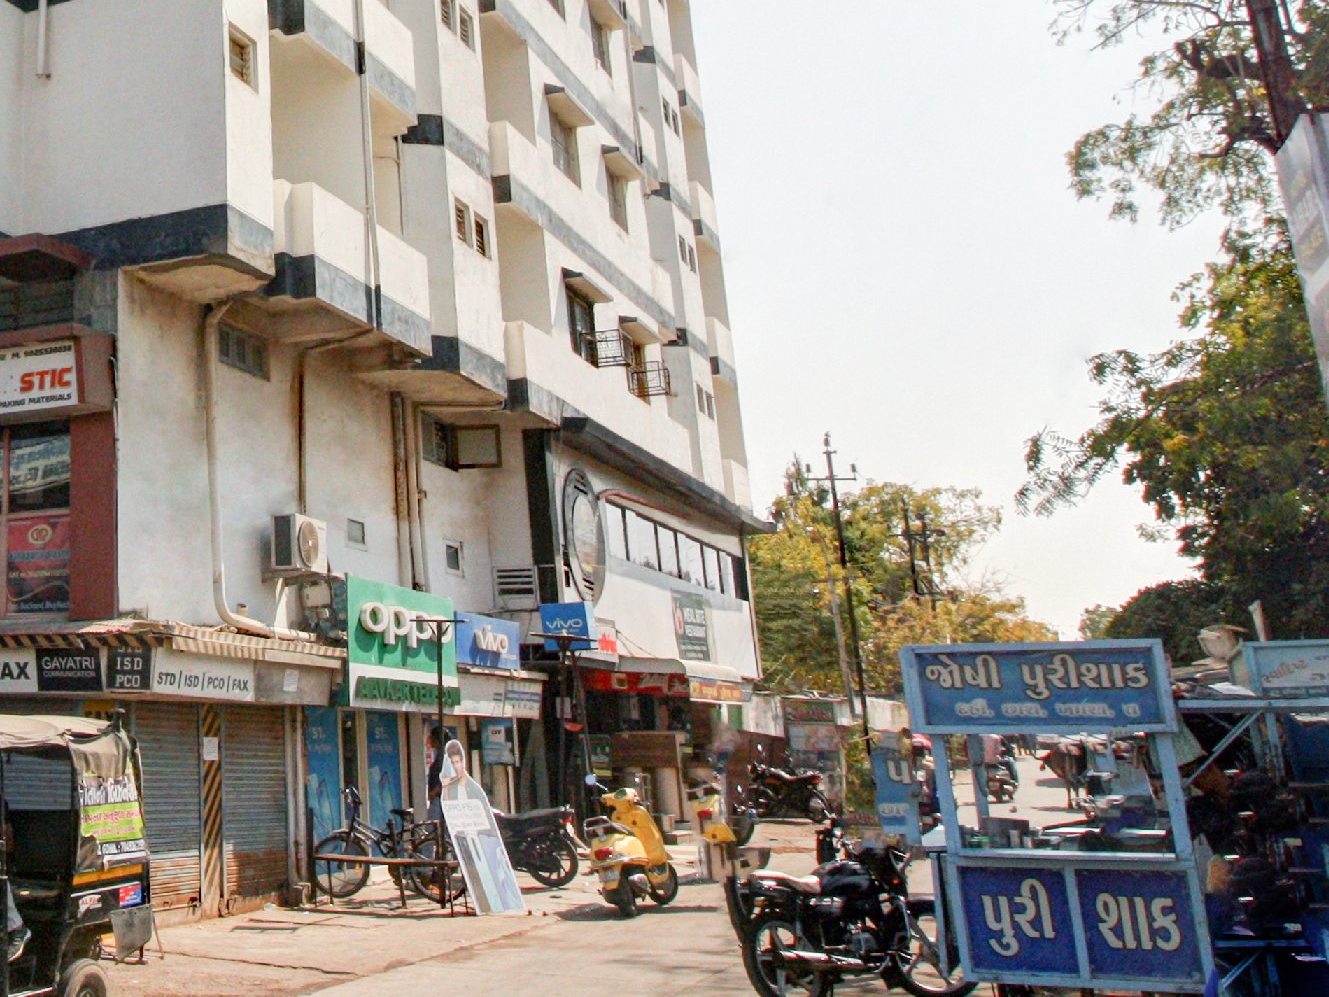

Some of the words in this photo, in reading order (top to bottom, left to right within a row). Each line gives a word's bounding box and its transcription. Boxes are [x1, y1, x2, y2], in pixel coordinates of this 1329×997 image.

[20, 366, 73, 393] STIC
[28, 392, 72, 405] MATERIALS
[361, 602, 452, 648] oppo
[546, 617, 584, 629] vivo
[475, 625, 509, 653] vivo
[41, 656, 95, 670] GAYATRI
[117, 657, 143, 670] ISD
[42, 670, 96, 678] COMMUNICATION
[114, 675, 141, 688] PCO
[157, 671, 176, 686] STD
[184, 674, 199, 688] ISD
[207, 676, 225, 690] PCO
[232, 678, 249, 692] FAX
[925, 654, 1002, 690] જોષી
[1022, 654, 1150, 701] પુરીશાક
[980, 878, 1057, 957] પુરી
[1095, 892, 1182, 952] શાક
